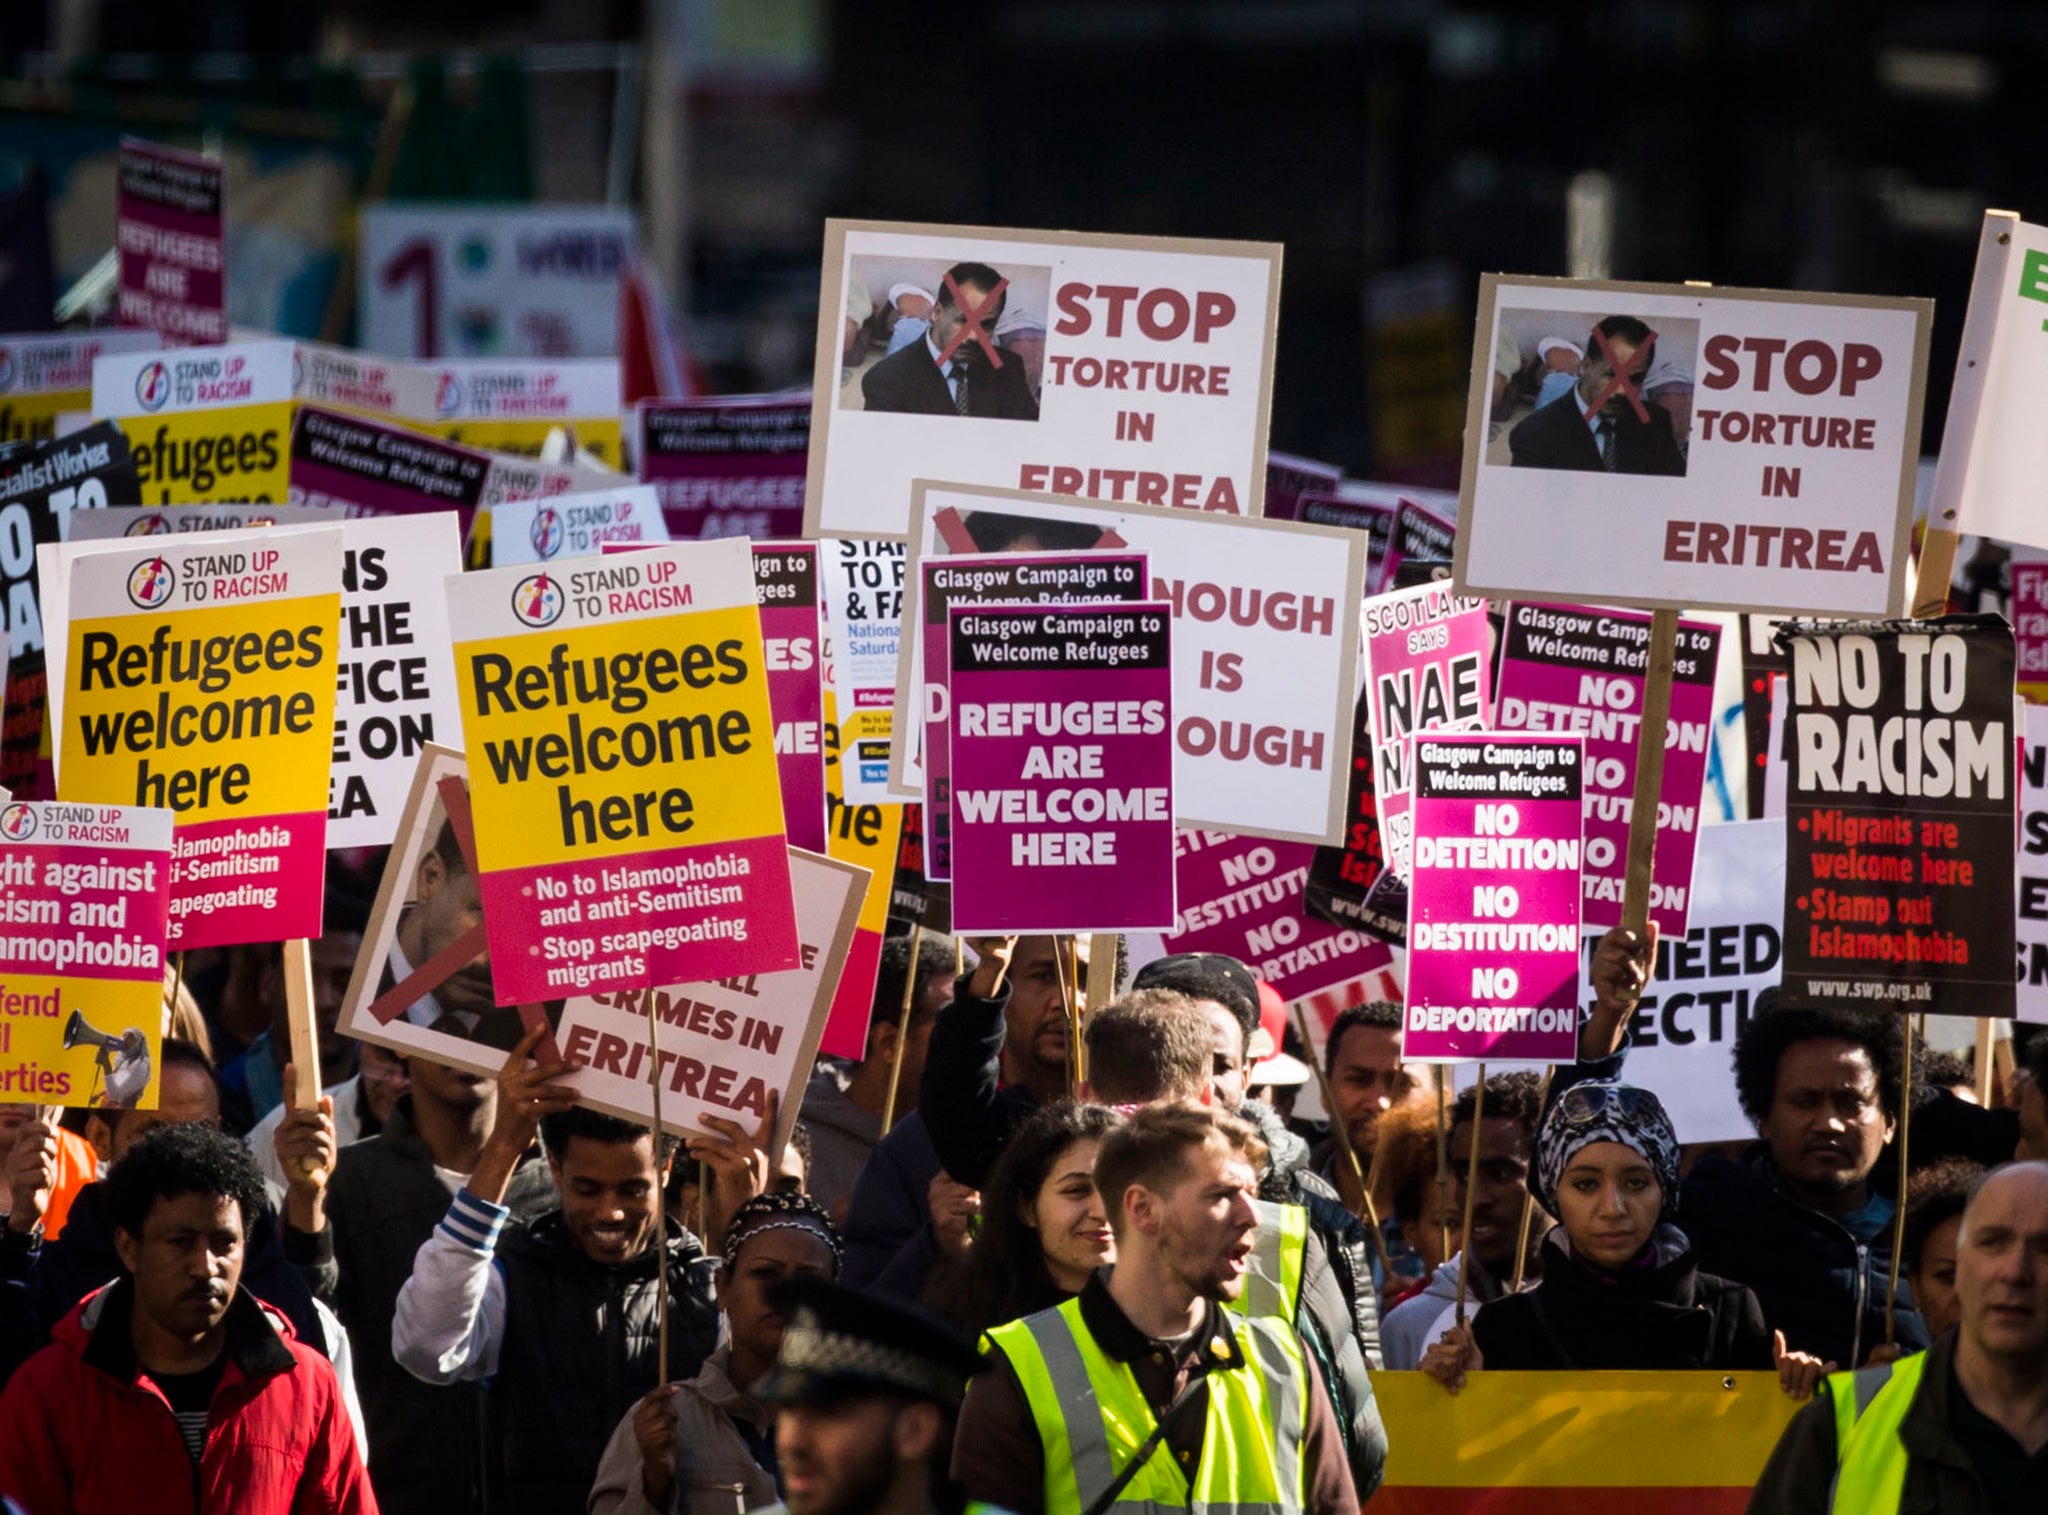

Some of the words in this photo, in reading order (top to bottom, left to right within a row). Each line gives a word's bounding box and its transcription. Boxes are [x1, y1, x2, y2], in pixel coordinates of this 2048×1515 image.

[1054, 282, 1237, 343] STOP
[174, 360, 221, 380] STAND
[225, 356, 246, 377] UP
[1049, 356, 1231, 397] TORTURE
[1702, 334, 1883, 397] STOP
[175, 384, 194, 404] TO
[197, 380, 252, 399] RACISM
[1115, 411, 1155, 443] IN
[1696, 409, 1876, 450] TORTURE
[128, 425, 279, 493] efugees
[657, 476, 808, 509] EFUGEE
[1019, 464, 1241, 517] ERITREA
[1761, 466, 1801, 498] IN
[567, 505, 612, 527] STAND
[615, 503, 632, 521] UP
[0, 502, 34, 580] O
[567, 530, 588, 548] TO
[592, 524, 642, 542] RACISM
[1663, 520, 1885, 574] ERITREA
[182, 554, 246, 578] STAND
[252, 550, 279, 572] UP
[571, 566, 640, 595] STAND
[646, 561, 677, 585] UP
[841, 560, 882, 589] TO
[934, 570, 1009, 592] Glasgow
[1015, 565, 1107, 588] Campaign
[1113, 566, 1133, 582] to
[182, 580, 207, 602] TO
[213, 572, 288, 600] RACISM
[573, 596, 603, 619] TO
[609, 584, 693, 615] RACISM
[1152, 577, 1335, 636] NOUGH
[848, 623, 900, 638] Nationa
[959, 616, 1036, 640] Glasgow
[1042, 615, 1136, 640] Campaign
[1140, 615, 1160, 633] to
[1408, 627, 1447, 654] SAYS
[1518, 606, 1597, 637] Glasgow
[1597, 618, 1685, 648] Campn
[1691, 631, 1711, 650] to
[80, 624, 324, 694] Refugees
[972, 643, 1059, 663] Welcome
[1065, 642, 1149, 665] Refugees
[1199, 650, 1244, 693] IS
[1526, 633, 1610, 662] Welcome
[1614, 647, 1697, 676] Refes
[471, 639, 748, 717] Refugees
[1578, 674, 1636, 711] NO
[1791, 634, 1881, 709] NO
[1898, 634, 1967, 714] TO
[1380, 652, 1479, 743] NAE
[80, 691, 315, 757] welcome
[359, 713, 435, 761] ON
[959, 701, 1165, 737] REFUGEES
[1500, 697, 1707, 754] DETENTON
[483, 709, 752, 785] welcome
[1020, 744, 1104, 779] ARE
[1177, 716, 1325, 771] OUGH
[1420, 743, 1480, 768] Glasgow
[1483, 744, 1555, 769] Campaign
[1558, 748, 1576, 765] to
[1796, 713, 2005, 800] RACISM
[136, 759, 250, 812] here
[1429, 770, 1497, 791] Welcome
[1499, 771, 1567, 796] Refugees
[44, 806, 95, 823] STAND
[100, 809, 122, 825] UP
[557, 785, 695, 847] here
[956, 787, 1169, 823] WELCOME
[1474, 804, 1519, 836] NO
[44, 824, 63, 840] TO
[68, 825, 129, 843] RACISM
[1811, 809, 1913, 848] Migrants
[1921, 819, 1959, 850] are
[1010, 832, 1117, 866] HERE
[1219, 846, 1276, 887] NO
[1416, 837, 1579, 870] DETENTION
[44, 857, 156, 894] against
[535, 877, 568, 900] No
[572, 873, 597, 896] to
[602, 853, 751, 892] Islamophobia
[1811, 852, 1913, 884] welcome
[1922, 853, 1974, 888] here
[0, 891, 61, 925] ism
[69, 896, 126, 929] and
[540, 900, 581, 927] and
[587, 883, 743, 921] anti-Semitism
[1168, 867, 1309, 940] DESTITUTI
[1473, 885, 1519, 918] NO
[1810, 889, 1890, 926] Stamp
[1897, 895, 1934, 926] out
[542, 934, 595, 962] Stop
[601, 916, 748, 954] scapegoating
[1244, 916, 1301, 957] NO
[1414, 923, 1577, 952] DESTITUTION
[1809, 924, 1968, 966] Islamophobia
[547, 956, 646, 988] migrants
[1253, 929, 1381, 984] ORTATION
[1471, 967, 1518, 1000] NO
[1807, 979, 1932, 1003] www.swp.org.uk
[589, 989, 738, 1042] CRIMES
[740, 1016, 784, 1056] IN
[1409, 1005, 1574, 1033] DEPORTATION
[0, 1062, 71, 1096] rties
[563, 1023, 768, 1119] ERITREA
